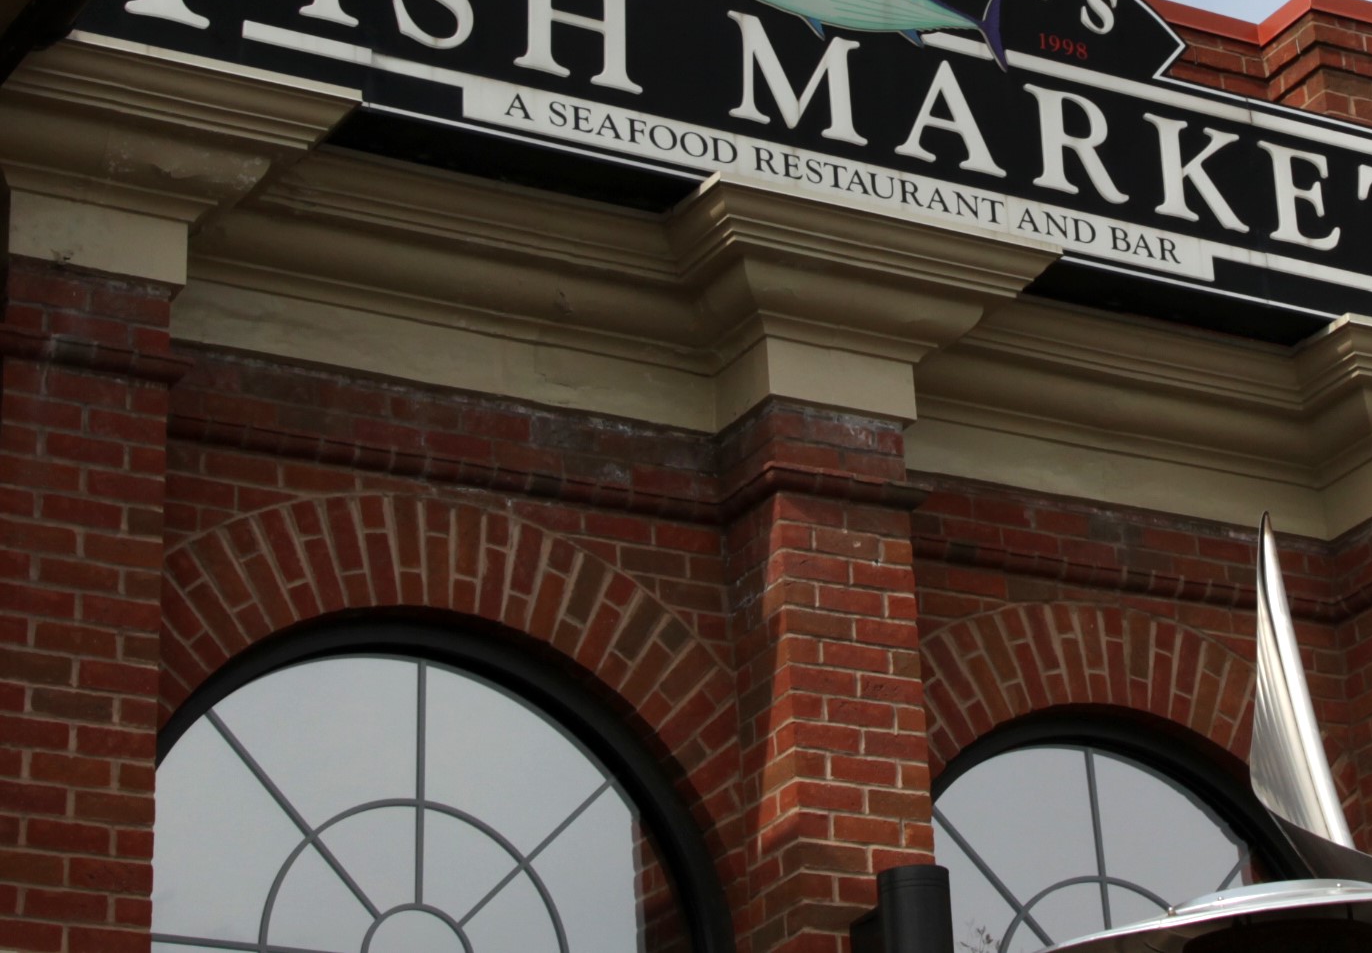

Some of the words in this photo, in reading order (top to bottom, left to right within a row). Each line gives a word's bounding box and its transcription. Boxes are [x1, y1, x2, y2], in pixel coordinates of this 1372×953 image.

[1038, 32, 1088, 61] 1998
[504, 93, 534, 122] A
[549, 99, 739, 165] SEAFOOD
[754, 146, 1005, 227] RESTAURANT
[1016, 206, 1098, 245] AND
[1109, 226, 1182, 265] BAR
